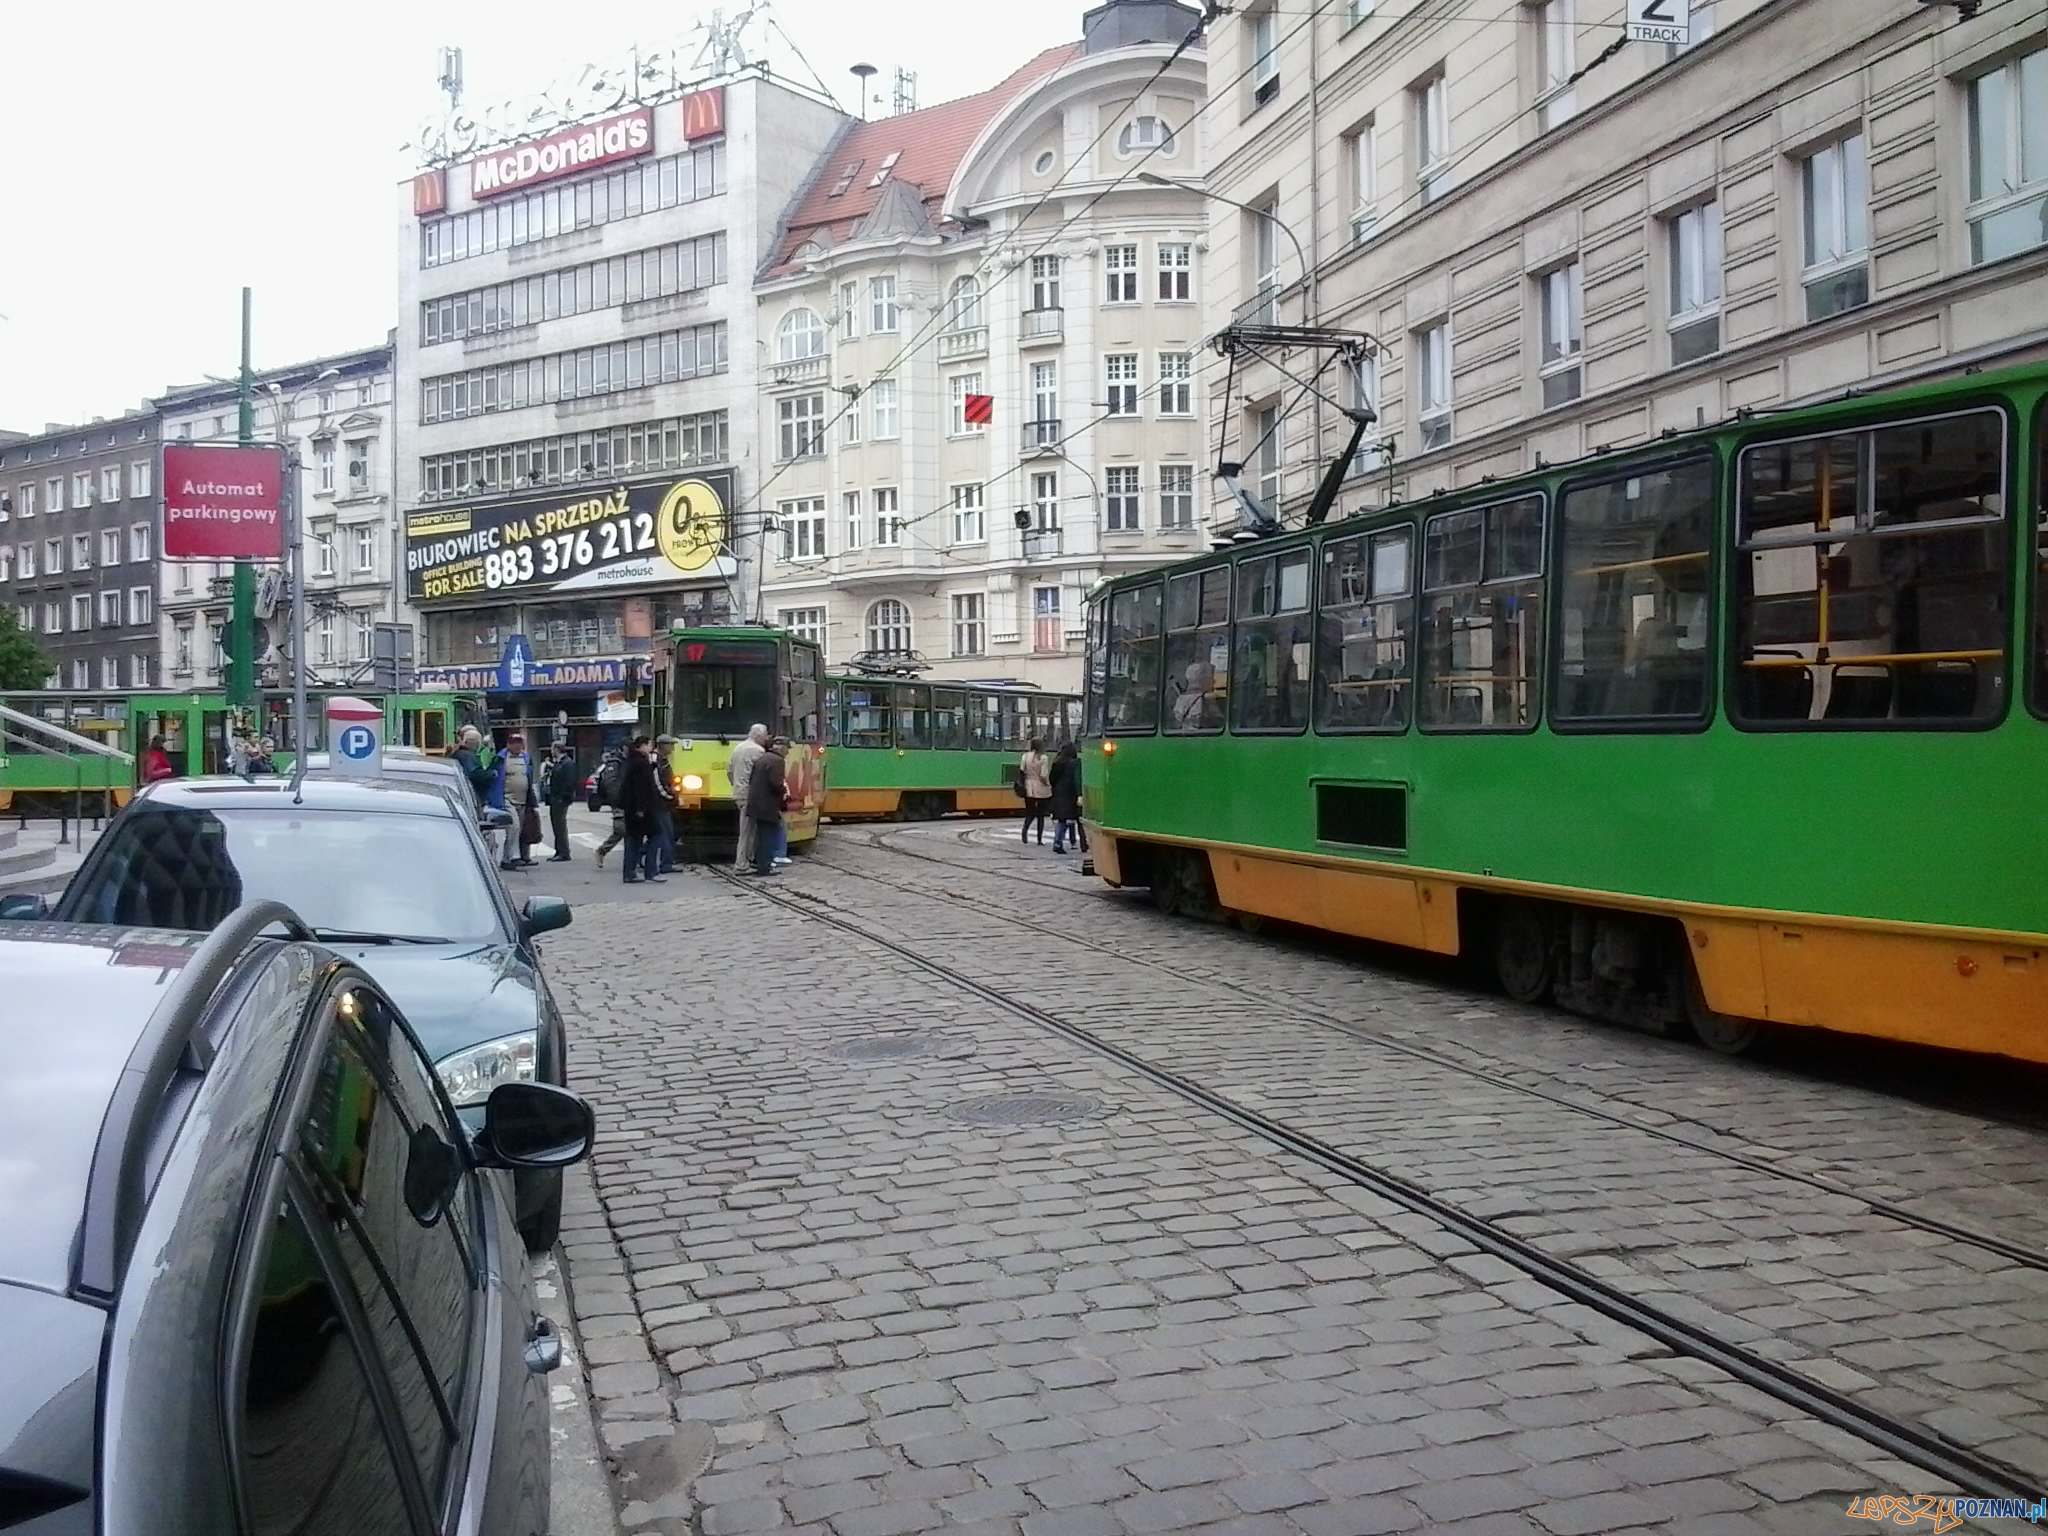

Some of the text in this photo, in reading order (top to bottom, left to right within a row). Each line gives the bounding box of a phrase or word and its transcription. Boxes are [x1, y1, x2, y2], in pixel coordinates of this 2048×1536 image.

[1633, 26, 1681, 41] TRACK
[474, 118, 648, 193] McDonald's
[182, 480, 264, 496] Automat
[169, 504, 277, 525] parkingowy
[408, 485, 630, 571] BIUROWIEC NA SPRZEDAŻ
[485, 513, 655, 589] 883 376 212
[422, 556, 483, 581] OFFICE BUILDING
[597, 564, 654, 580] metrohouse
[425, 568, 486, 599] FOR SALE
[530, 669, 553, 685] im.
[554, 663, 614, 685] ADAMA
